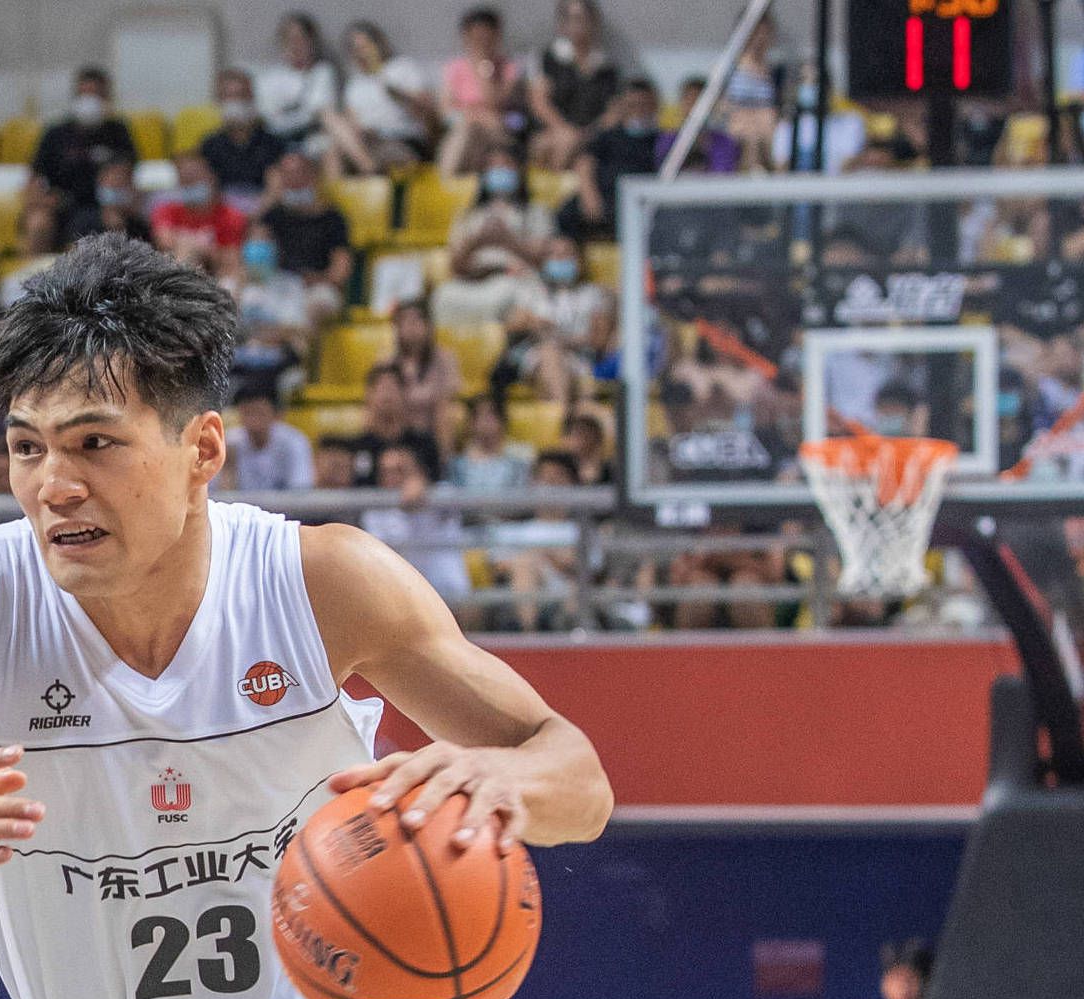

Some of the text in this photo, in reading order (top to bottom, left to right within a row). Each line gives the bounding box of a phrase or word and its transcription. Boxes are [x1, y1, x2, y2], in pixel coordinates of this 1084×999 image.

[237, 671, 300, 696] CUBA
[28, 715, 92, 732] RIGORER
[157, 813, 189, 824] FUSC
